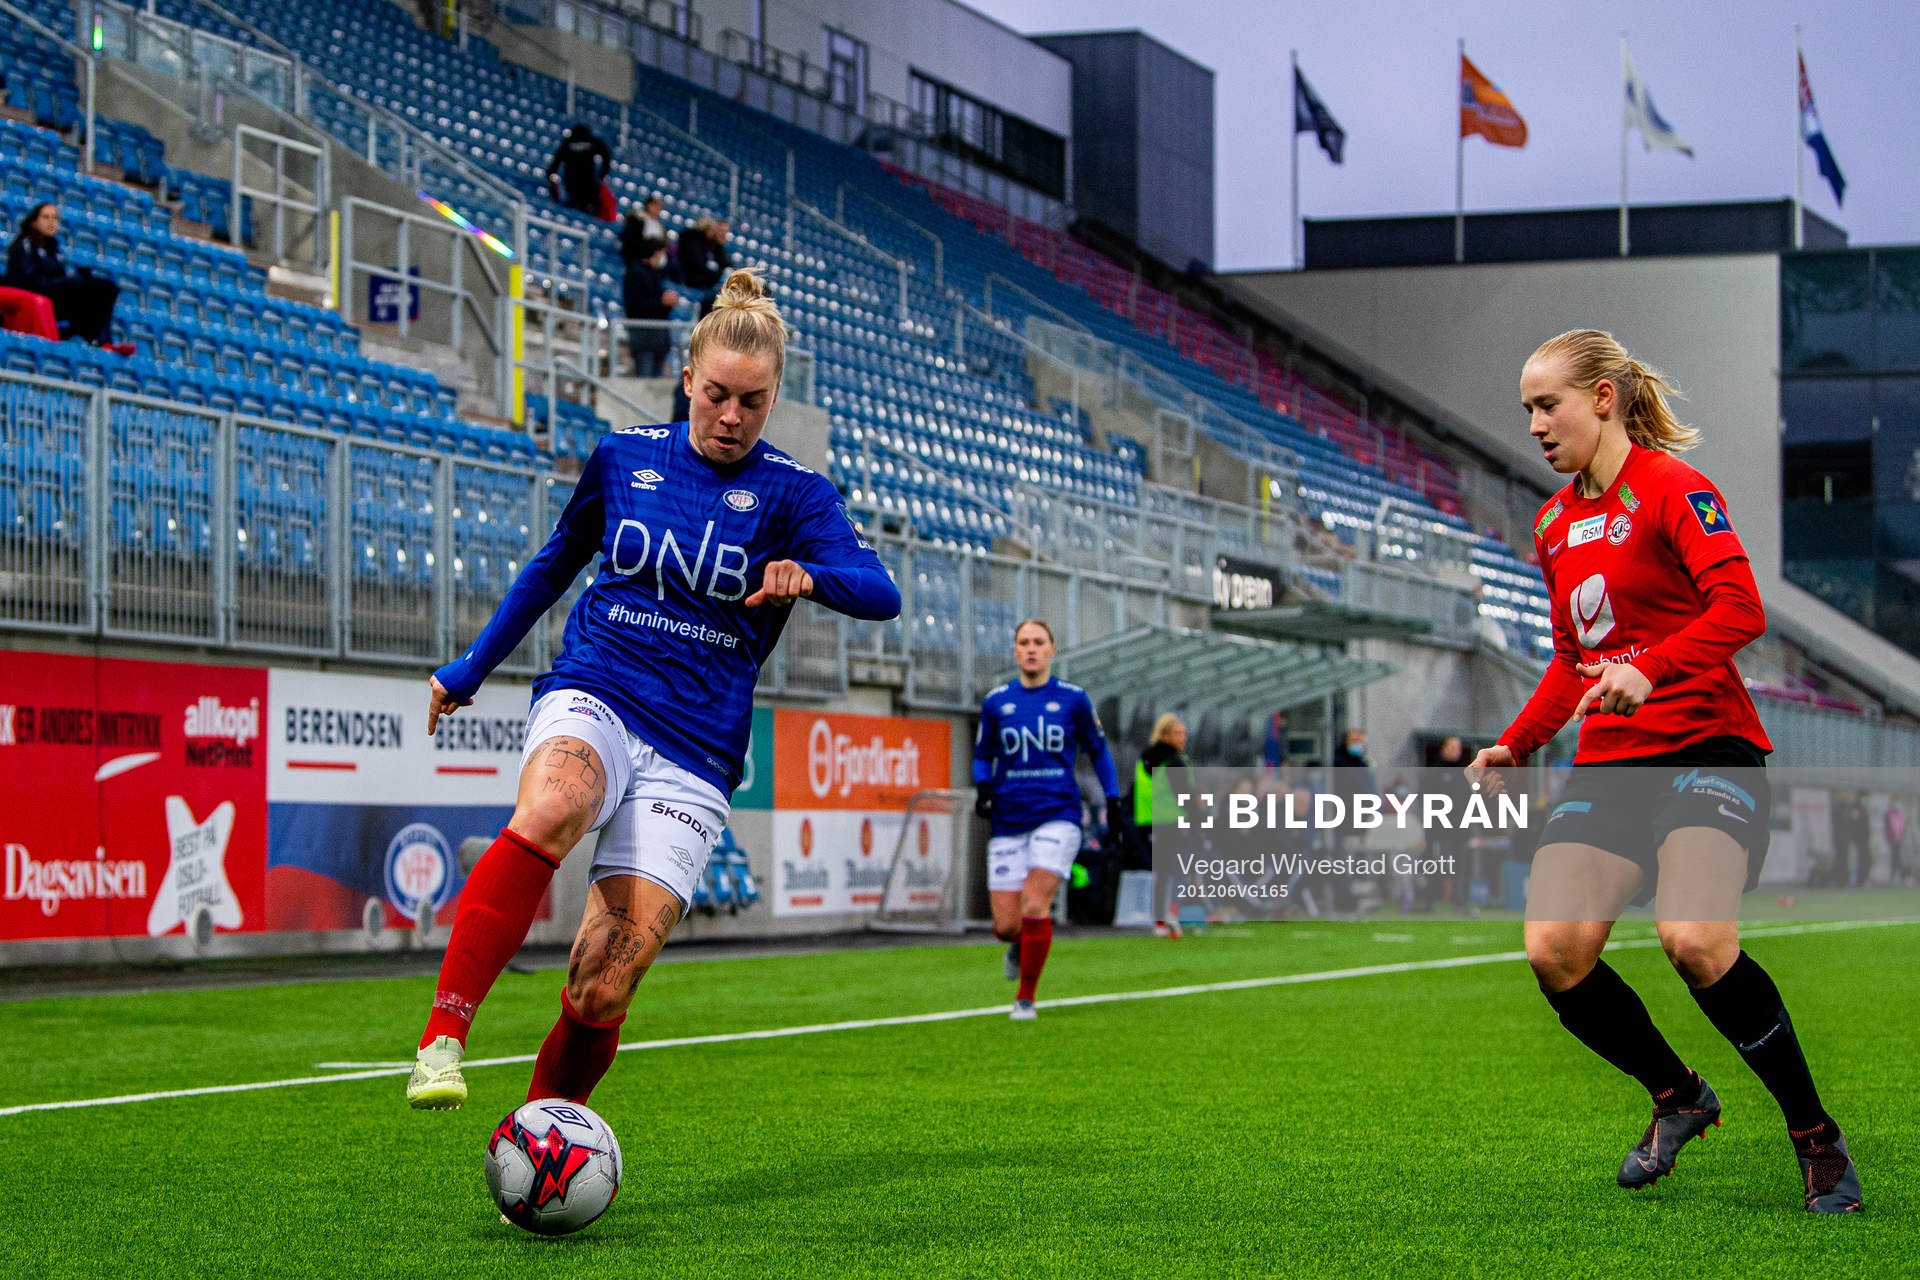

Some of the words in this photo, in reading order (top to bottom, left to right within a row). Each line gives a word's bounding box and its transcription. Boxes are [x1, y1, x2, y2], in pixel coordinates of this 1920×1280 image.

[630, 481, 657, 491] umbro
[1581, 524, 1603, 541] RSM
[612, 519, 749, 601] DNB
[608, 604, 741, 649] #huninvesterer
[184, 696, 259, 746] allkopi
[285, 707, 403, 749] BERENDSEN
[435, 716, 526, 753] BERENDSE
[1001, 714, 1065, 763] DNB
[186, 742, 253, 768] NetPrint
[833, 733, 919, 798] Fjordkraft
[542, 776, 587, 809] MISS
[650, 801, 707, 844] ŠKODA
[4, 843, 147, 917] Dagsavisen
